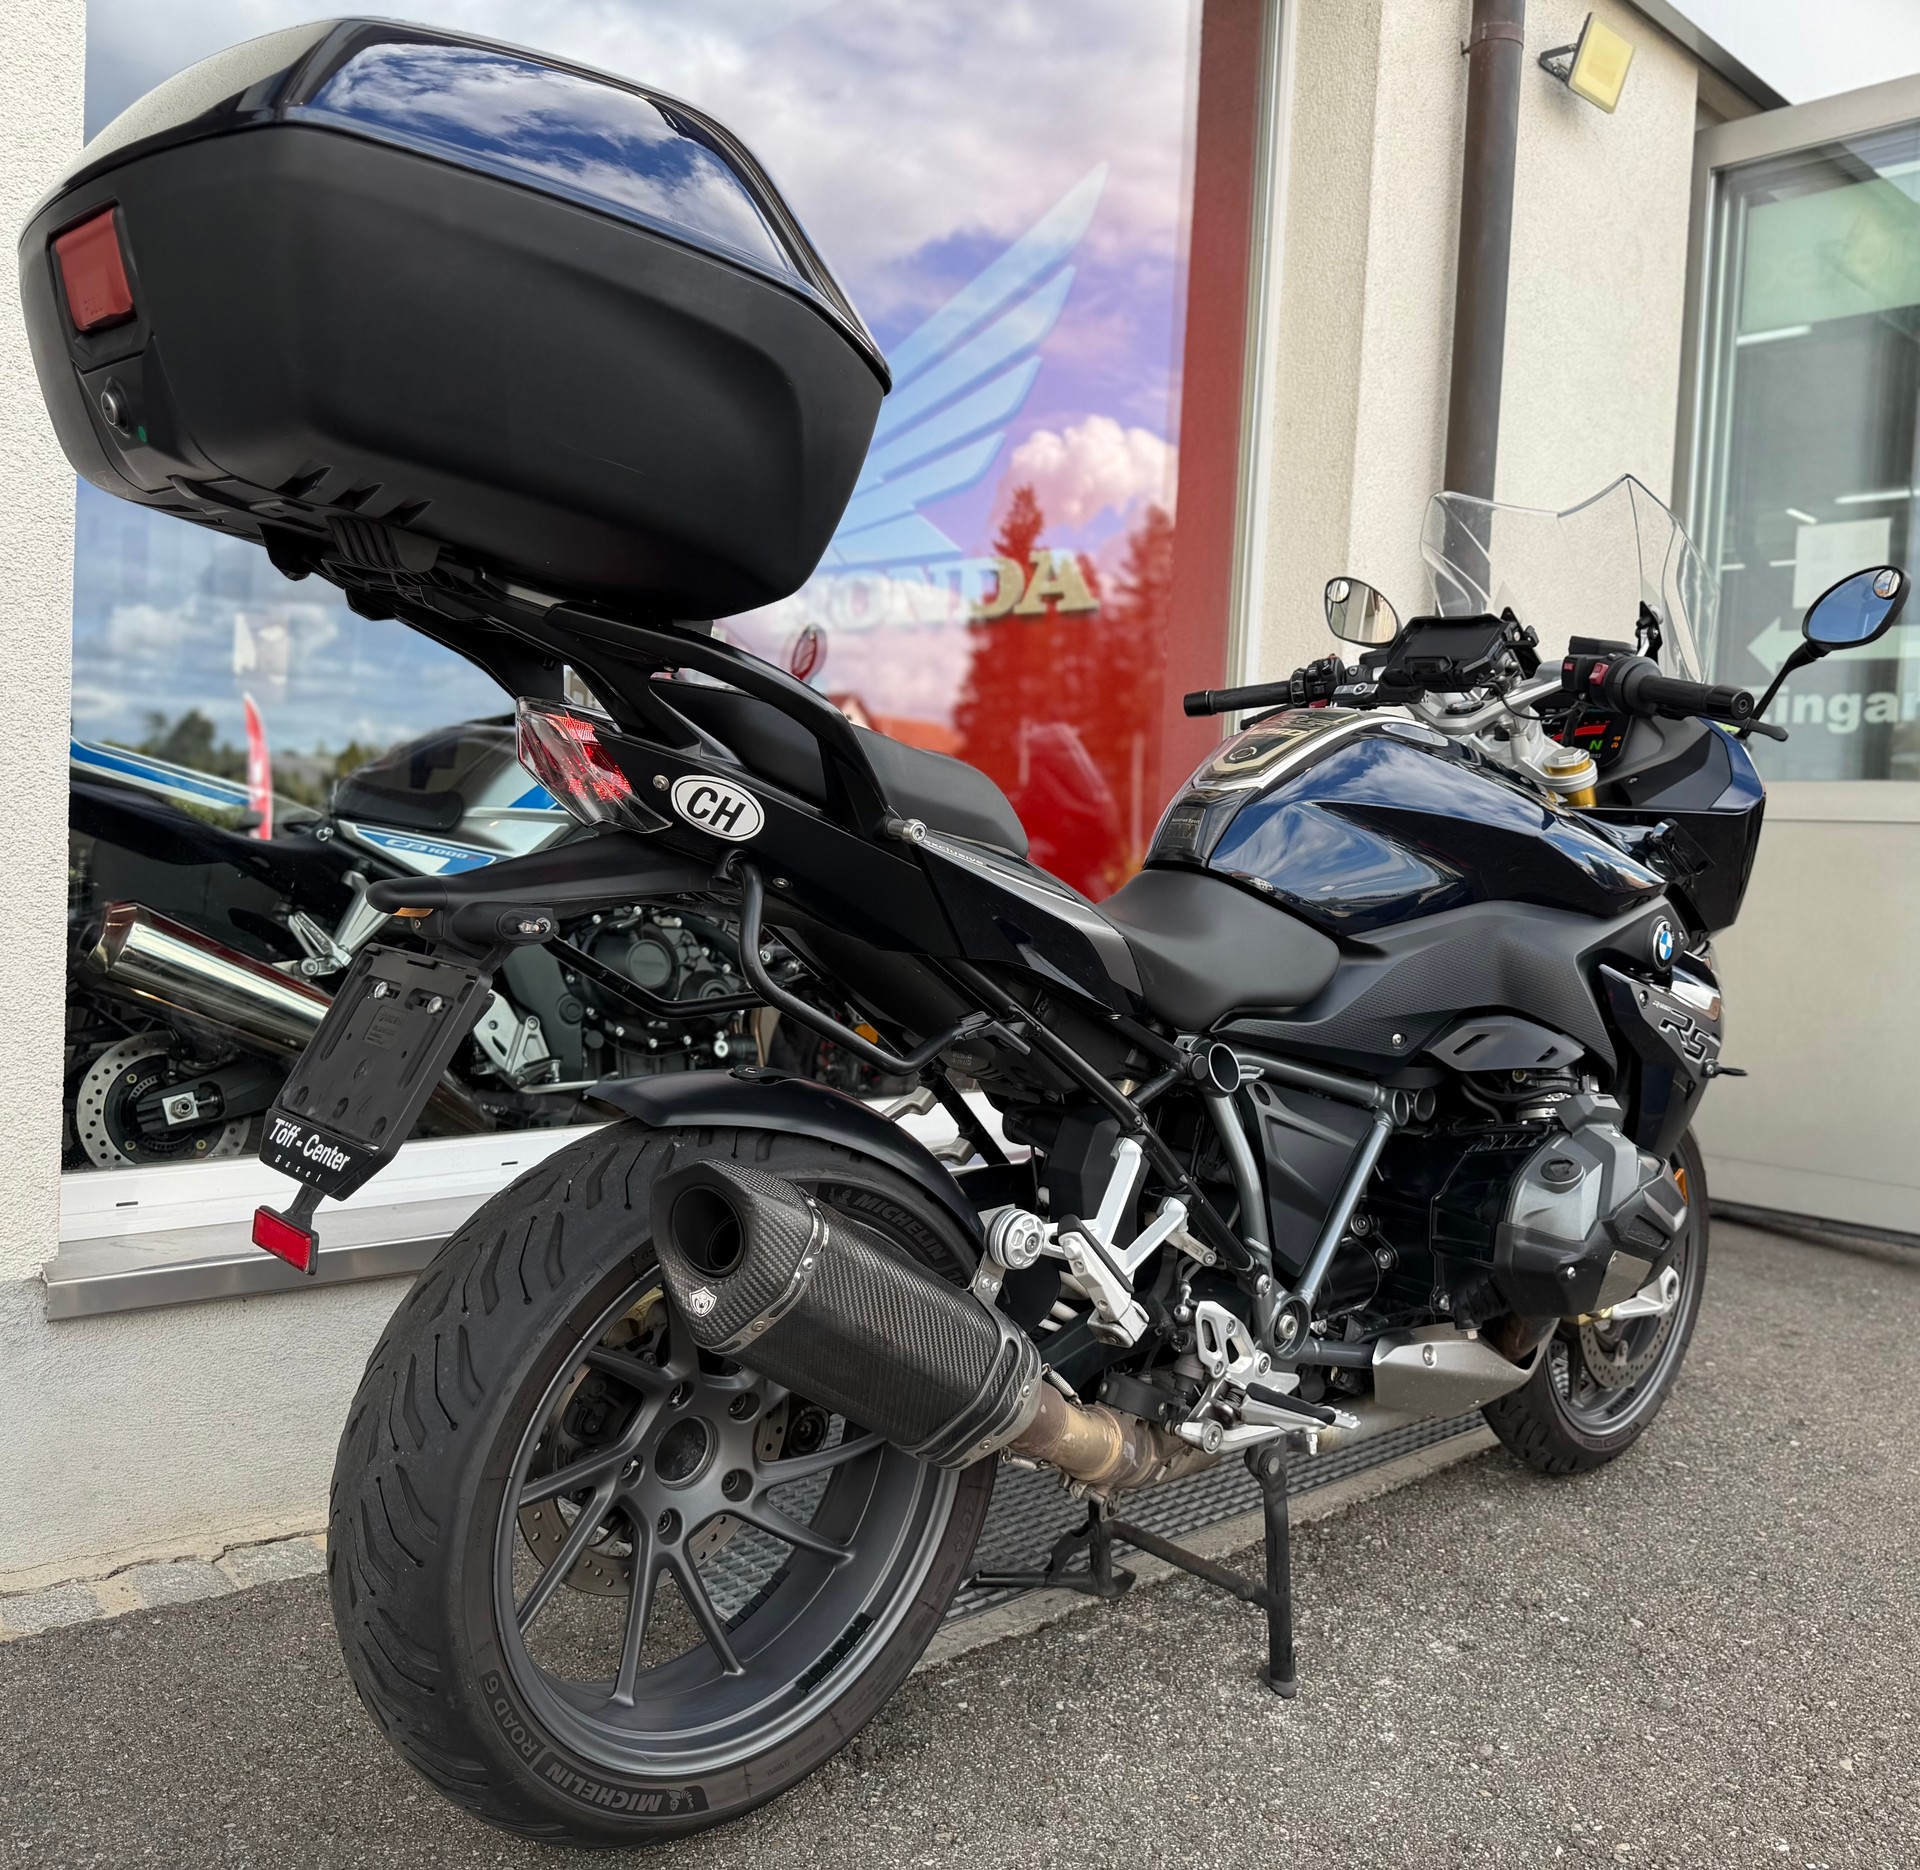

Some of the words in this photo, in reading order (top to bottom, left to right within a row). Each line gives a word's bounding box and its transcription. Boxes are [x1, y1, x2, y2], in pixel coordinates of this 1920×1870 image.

[1589, 740, 1603, 750] N
[687, 787, 746, 833] CH
[1658, 1007, 1720, 1065] RS
[303, 1134, 351, 1171] Center
[854, 1193, 946, 1260] MICHELIN
[484, 1676, 499, 1694] 6
[494, 1700, 538, 1758] ROAD
[545, 1761, 663, 1812] MICHELIN
